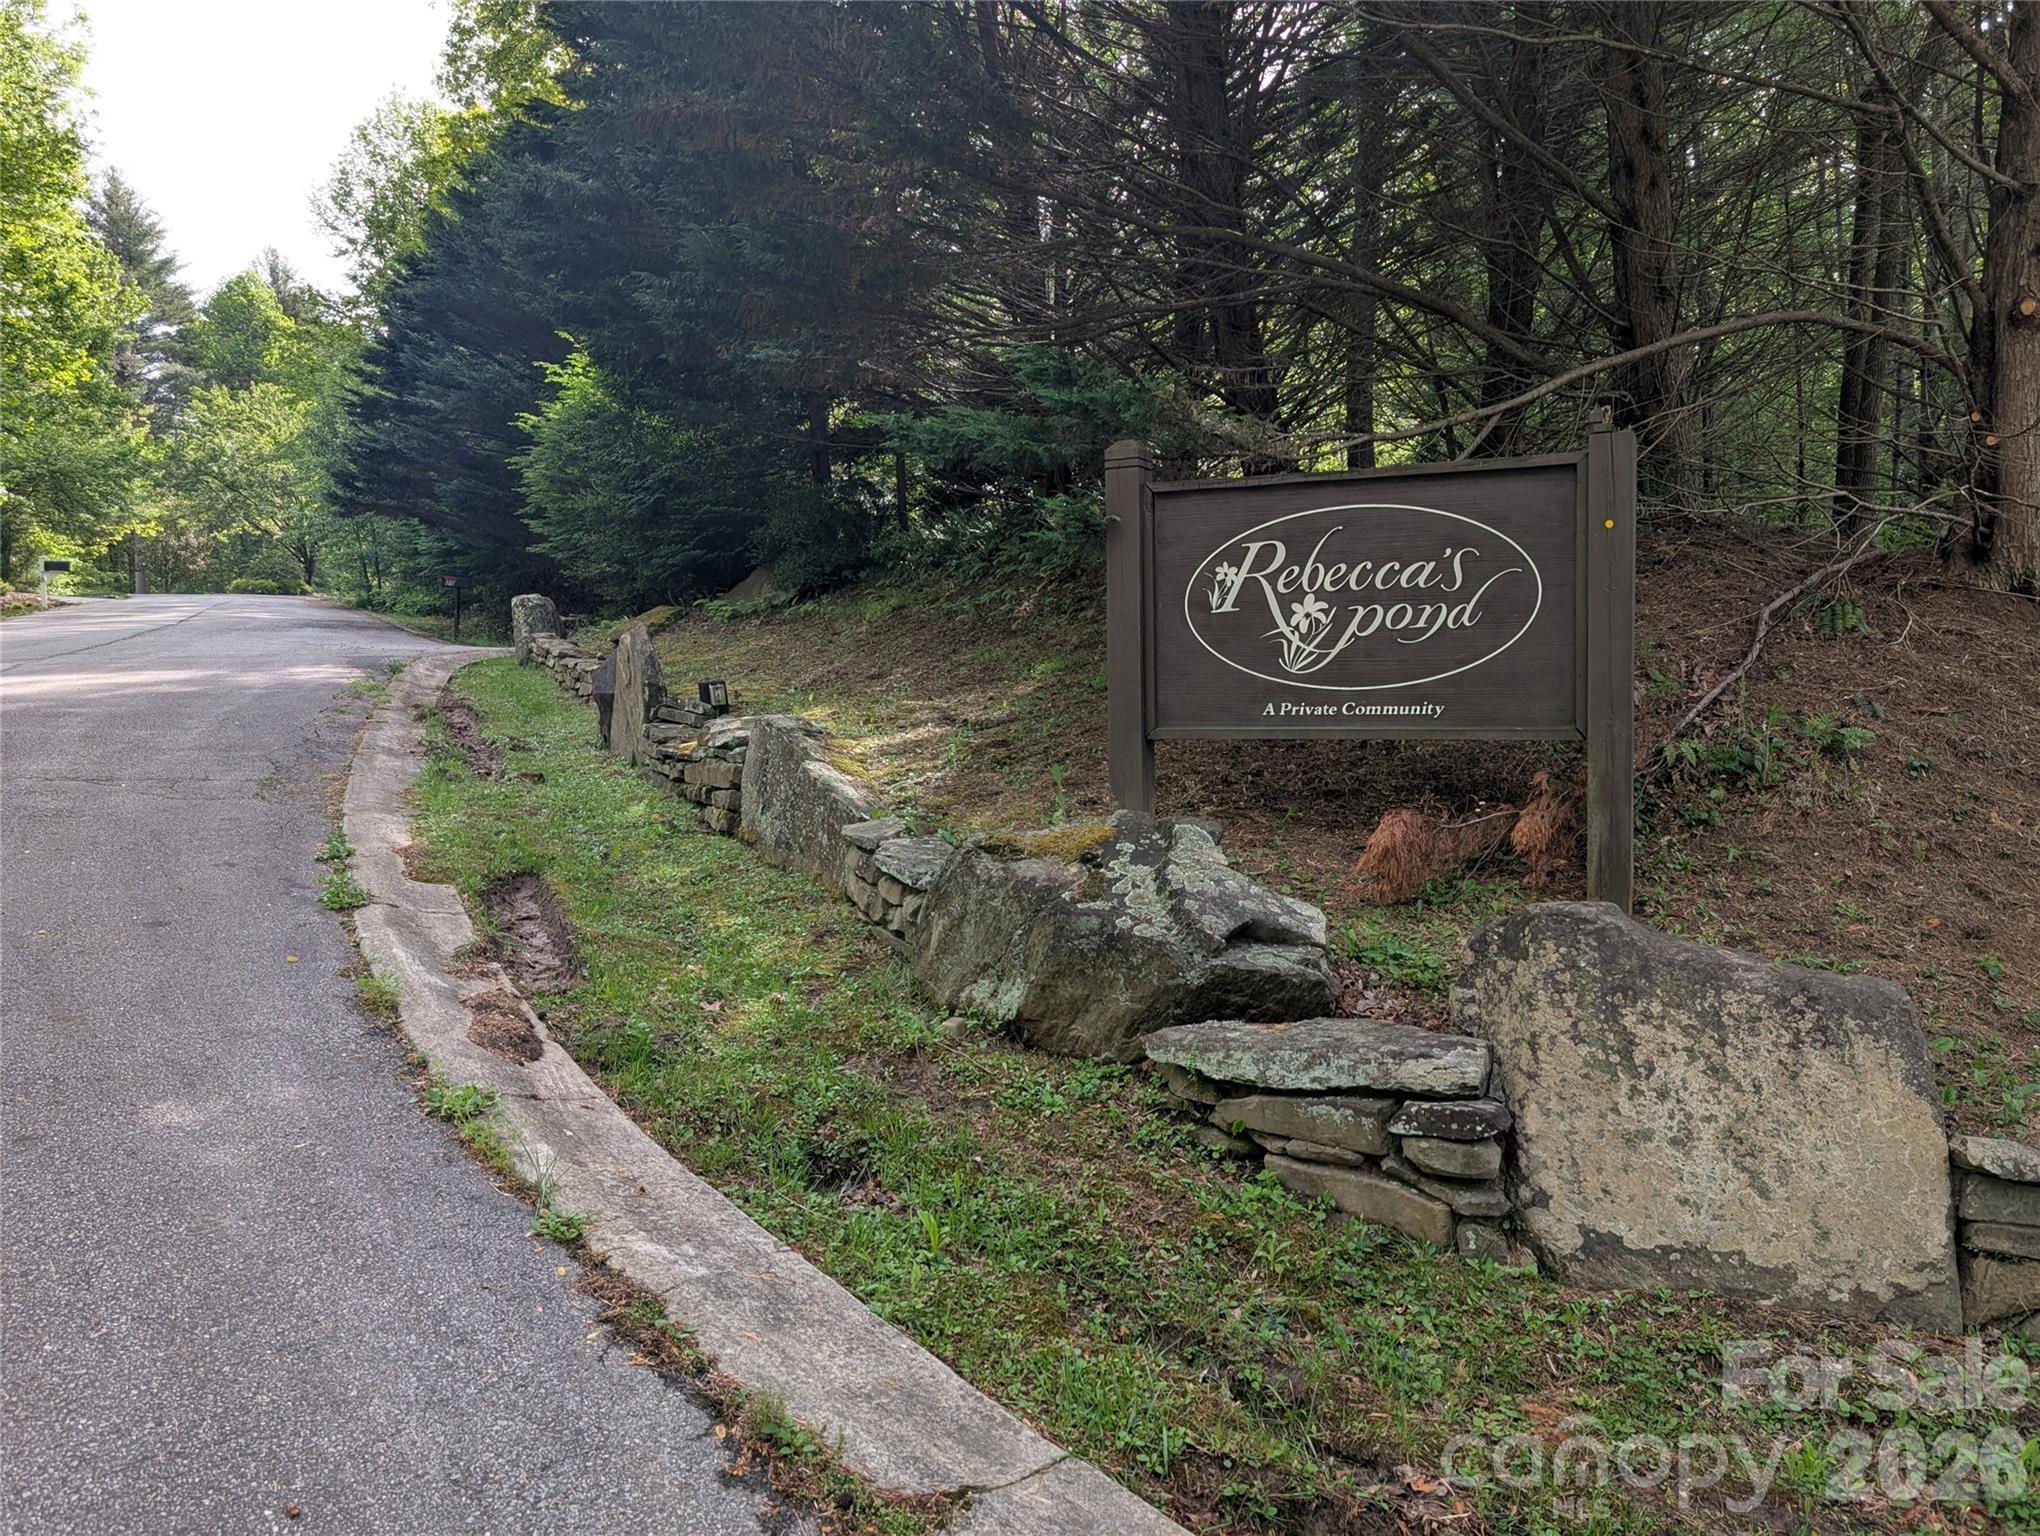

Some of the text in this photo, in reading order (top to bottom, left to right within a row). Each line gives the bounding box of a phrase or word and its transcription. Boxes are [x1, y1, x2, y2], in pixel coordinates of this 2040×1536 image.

[1210, 525, 1480, 650] Rebecca's
[1305, 568, 1523, 665] pond
[1262, 701, 1446, 719] A Private Community
